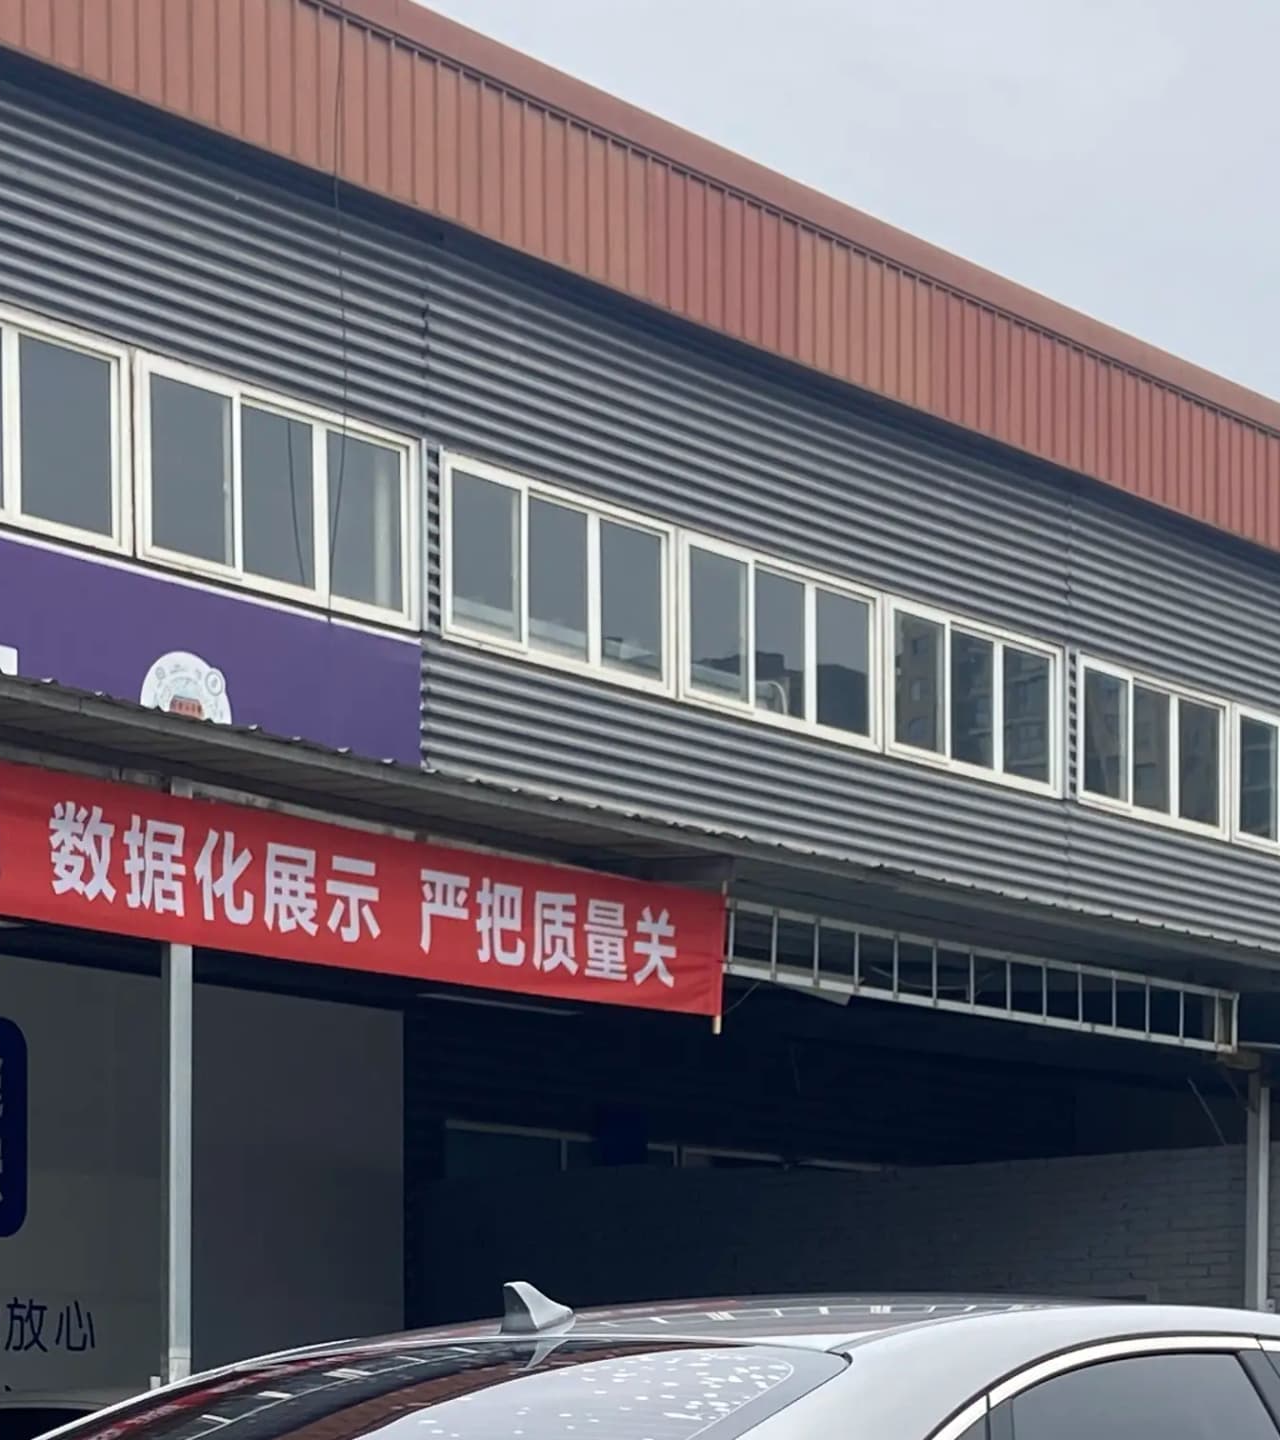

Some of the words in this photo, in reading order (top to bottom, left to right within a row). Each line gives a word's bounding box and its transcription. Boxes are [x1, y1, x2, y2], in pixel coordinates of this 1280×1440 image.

[49, 800, 382, 943] 数据化展示
[420, 868, 677, 989] 严把质量关
